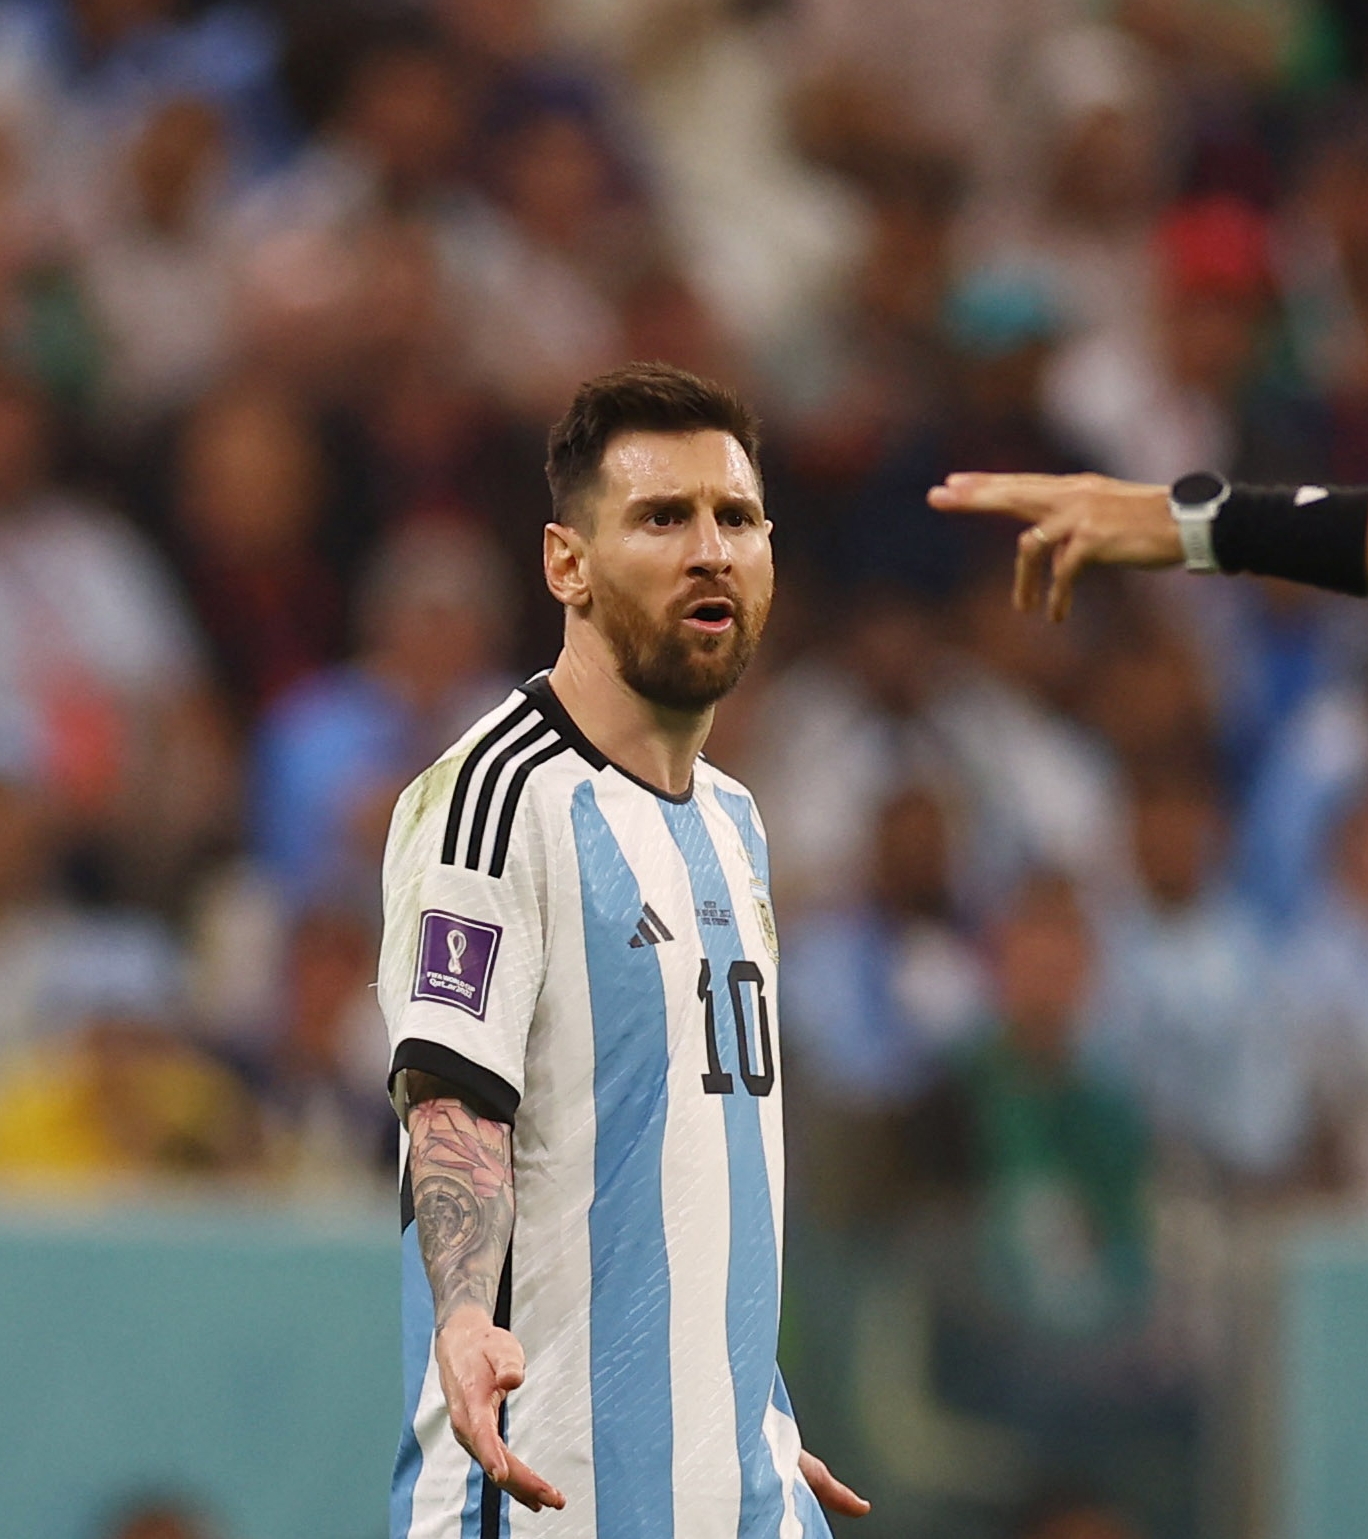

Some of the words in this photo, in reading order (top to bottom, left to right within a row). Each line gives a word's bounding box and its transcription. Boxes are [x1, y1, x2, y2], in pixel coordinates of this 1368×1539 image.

[426, 971, 443, 981] FIFA
[442, 974, 465, 988] WORLD
[697, 958, 775, 1097] 10
